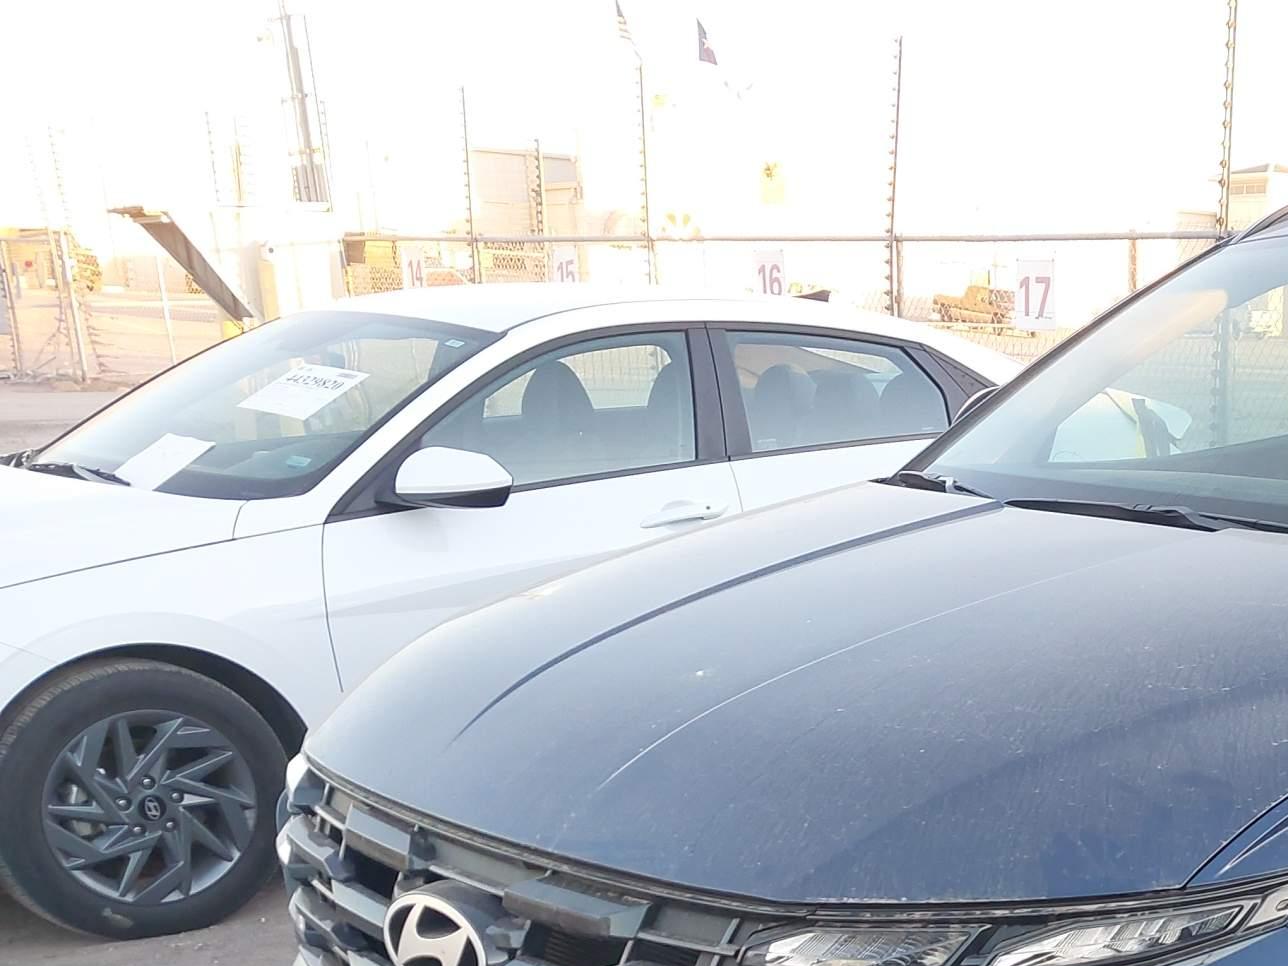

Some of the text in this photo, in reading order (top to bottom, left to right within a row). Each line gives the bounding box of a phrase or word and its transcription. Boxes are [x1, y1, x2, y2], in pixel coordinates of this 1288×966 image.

[407, 258, 424, 288] 14
[556, 259, 576, 283] 15
[757, 263, 783, 296] 16
[1019, 276, 1051, 318] 17
